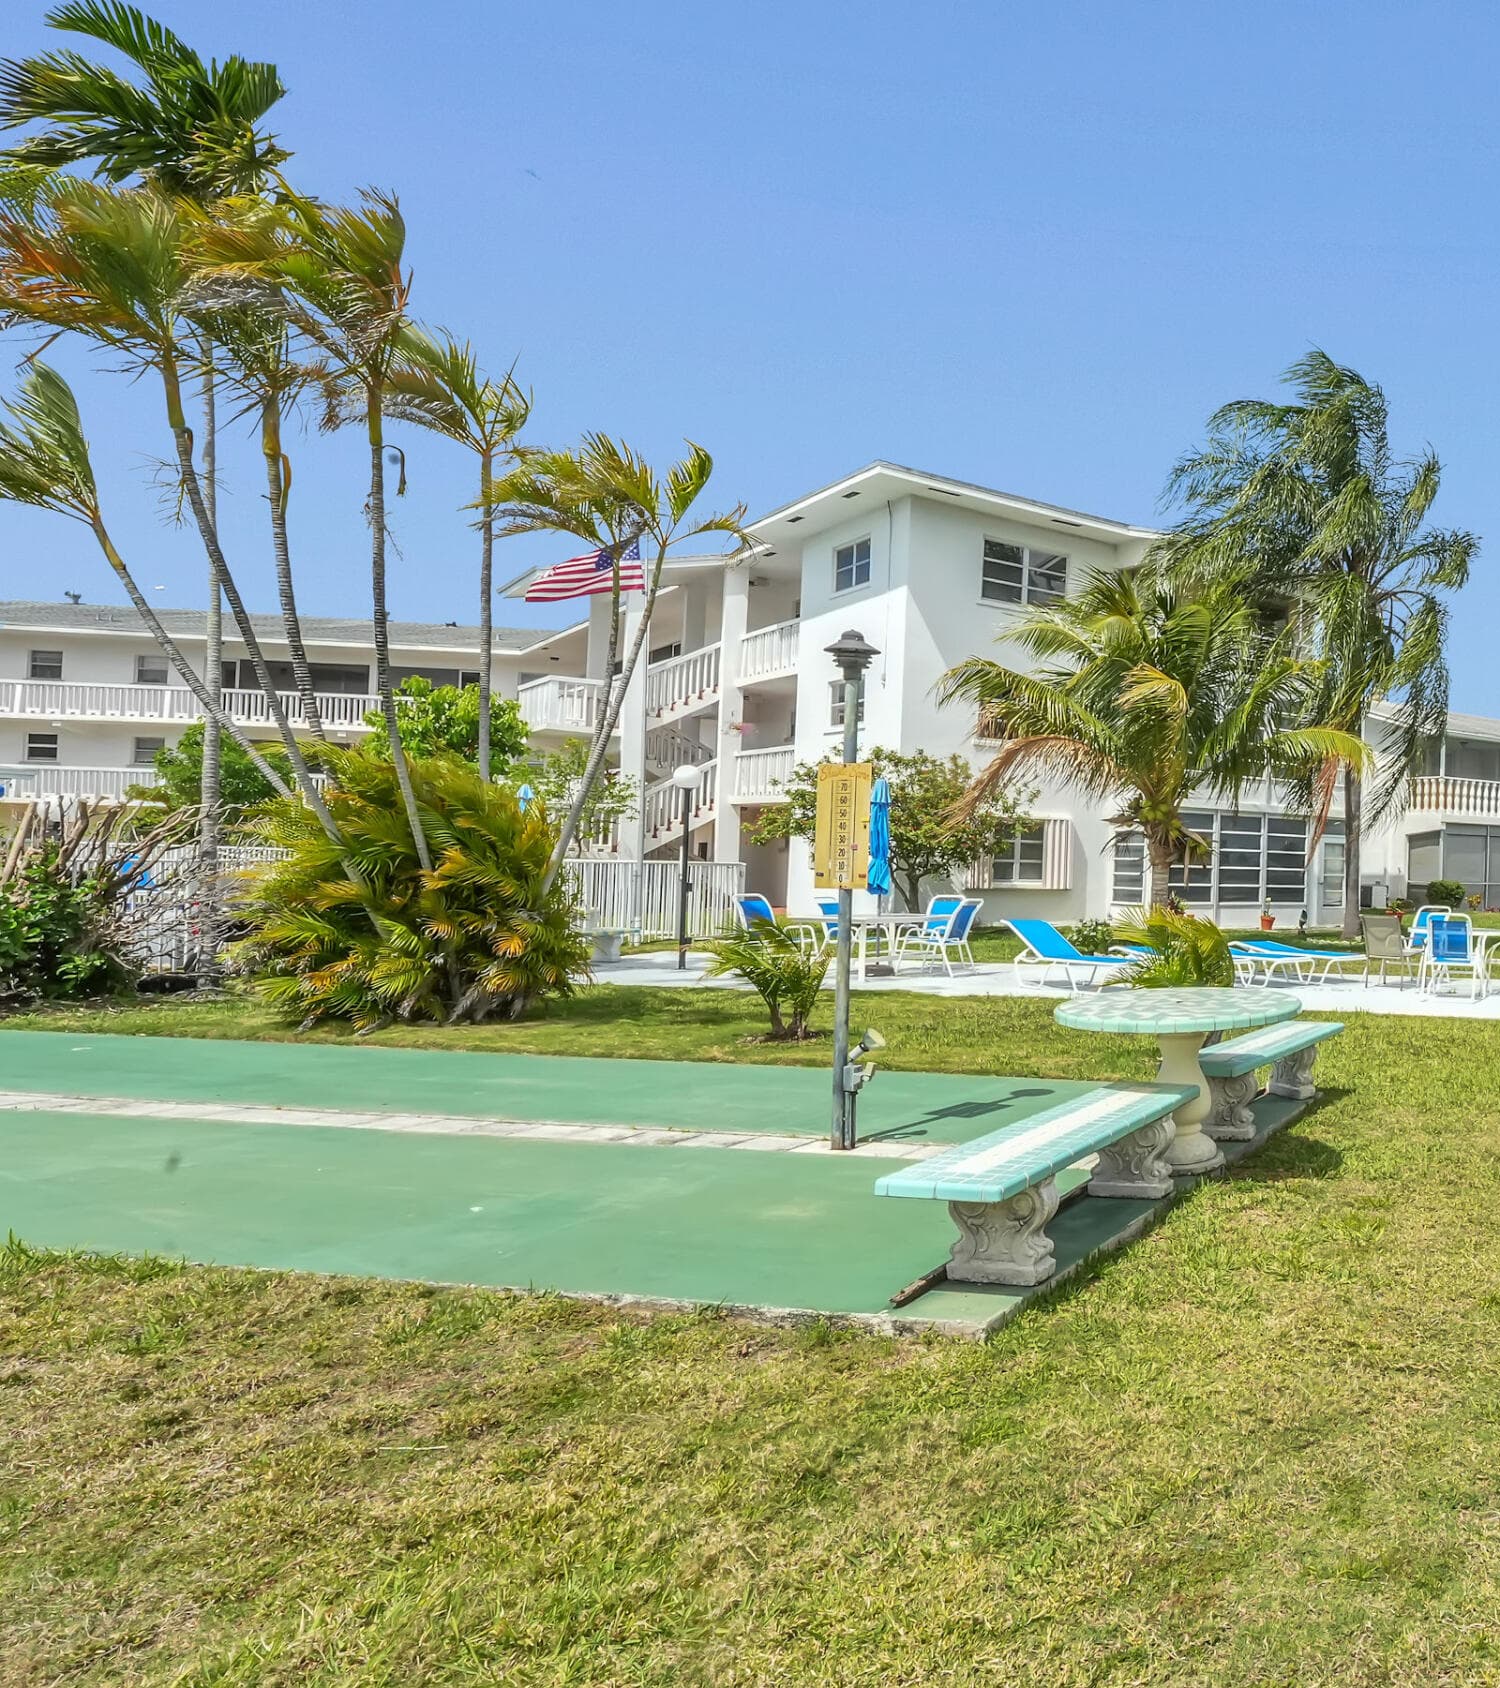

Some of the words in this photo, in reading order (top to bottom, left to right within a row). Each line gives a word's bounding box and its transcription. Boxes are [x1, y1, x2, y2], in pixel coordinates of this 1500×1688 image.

[841, 783, 848, 792] 70
[840, 795, 848, 805] 60
[840, 808, 848, 818] 50
[839, 821, 847, 831] 40
[838, 834, 846, 844] 30
[838, 847, 846, 857] 20
[838, 861, 845, 870] 10
[838, 873, 843, 883] 0
